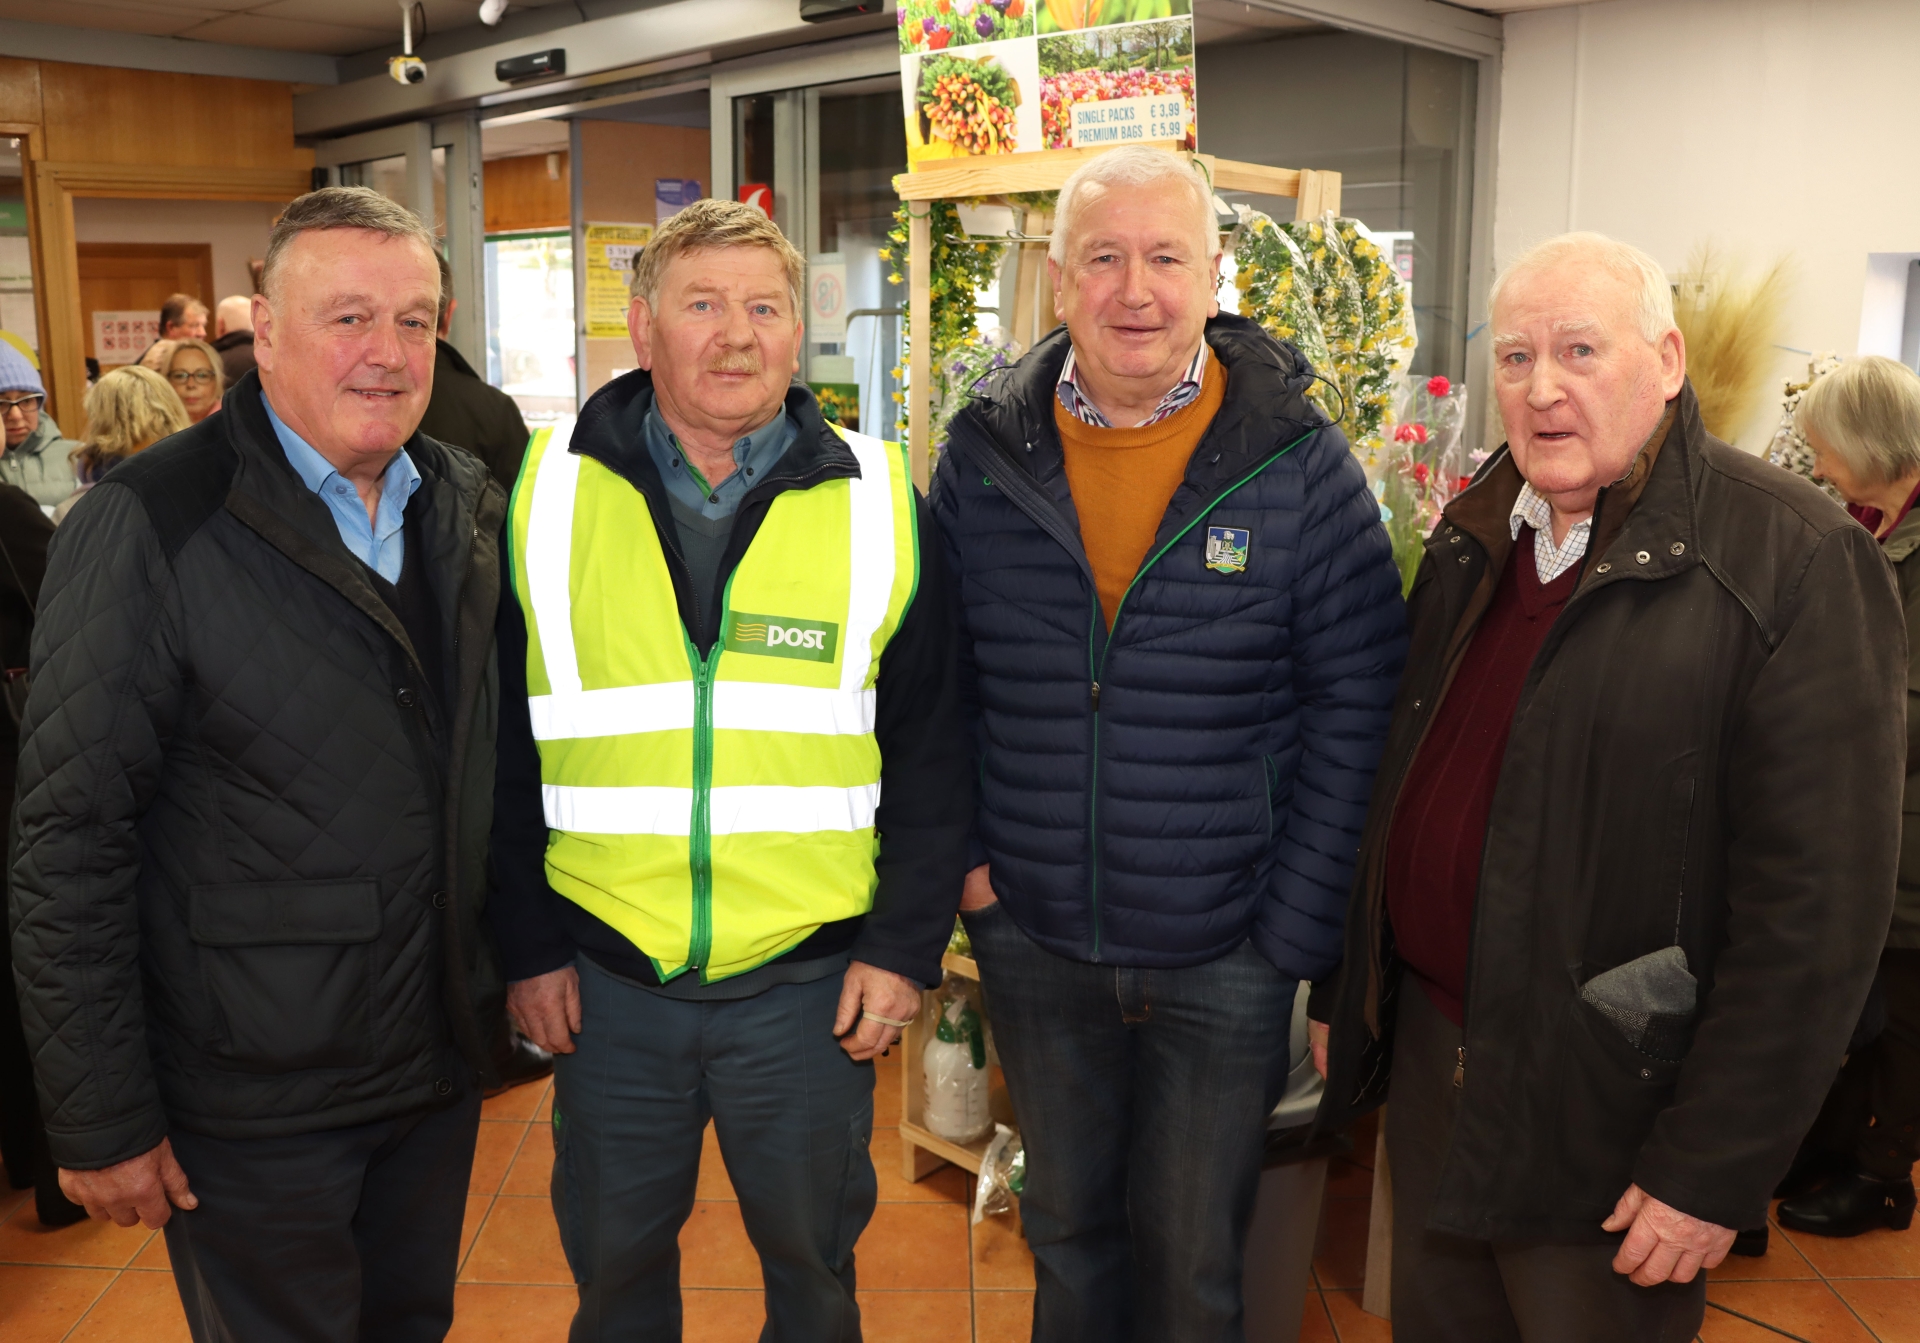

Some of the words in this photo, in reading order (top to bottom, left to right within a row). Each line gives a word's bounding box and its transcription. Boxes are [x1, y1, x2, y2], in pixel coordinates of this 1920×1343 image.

[1077, 109, 1106, 125] SINGLE
[1108, 106, 1135, 122] PACKS
[1150, 104, 1156, 118] €
[1159, 102, 1180, 118] 3,99
[1078, 126, 1118, 143] PREMIUM
[1121, 124, 1143, 140] BAGS
[1151, 123, 1157, 137] €
[1160, 121, 1180, 137] 5,99
